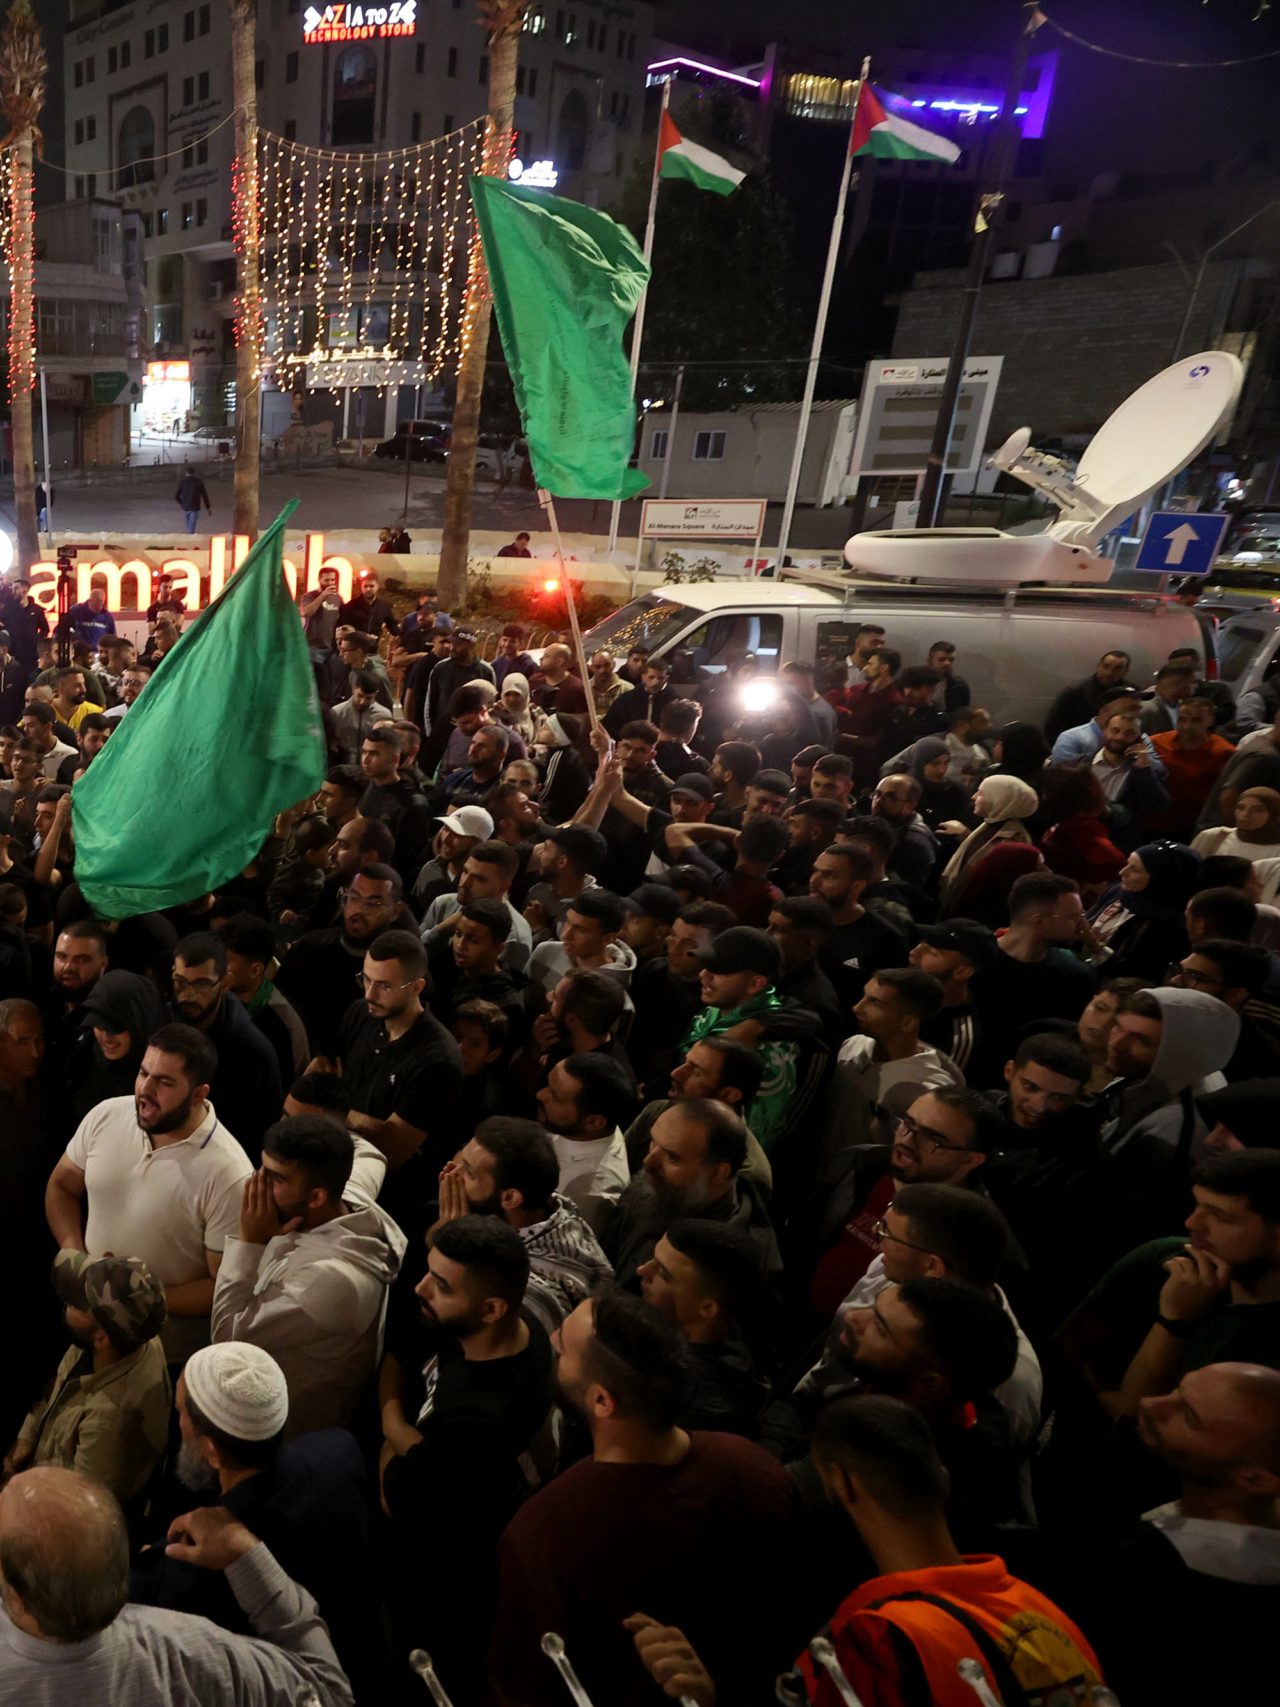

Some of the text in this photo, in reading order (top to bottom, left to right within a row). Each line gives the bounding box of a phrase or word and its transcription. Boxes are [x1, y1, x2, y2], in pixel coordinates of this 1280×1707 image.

[304, 22, 416, 44] TECHNOLOGY STORE
[682, 523, 705, 531] Square
